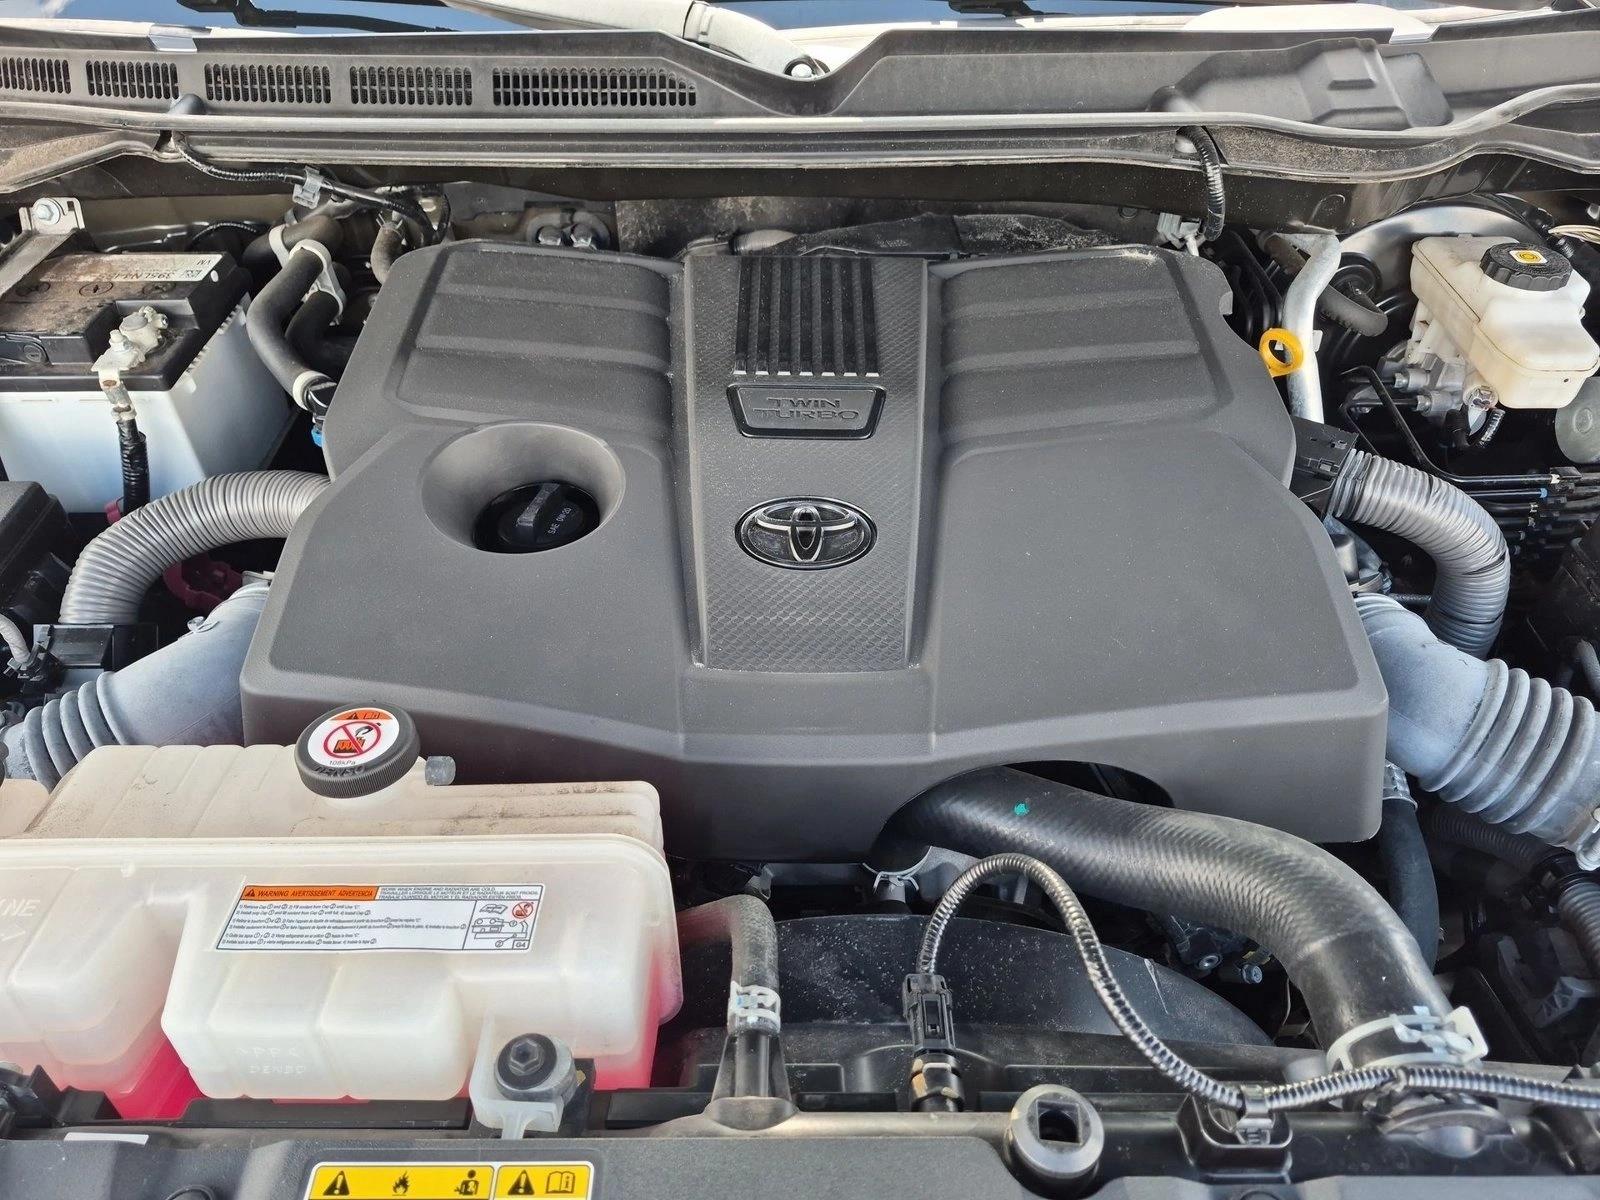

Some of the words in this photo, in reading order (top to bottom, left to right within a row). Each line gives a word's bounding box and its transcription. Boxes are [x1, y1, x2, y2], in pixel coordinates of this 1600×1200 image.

[767, 397, 840, 409] TWIN
[753, 408, 859, 420] TURBO
[547, 523, 560, 535] SAE
